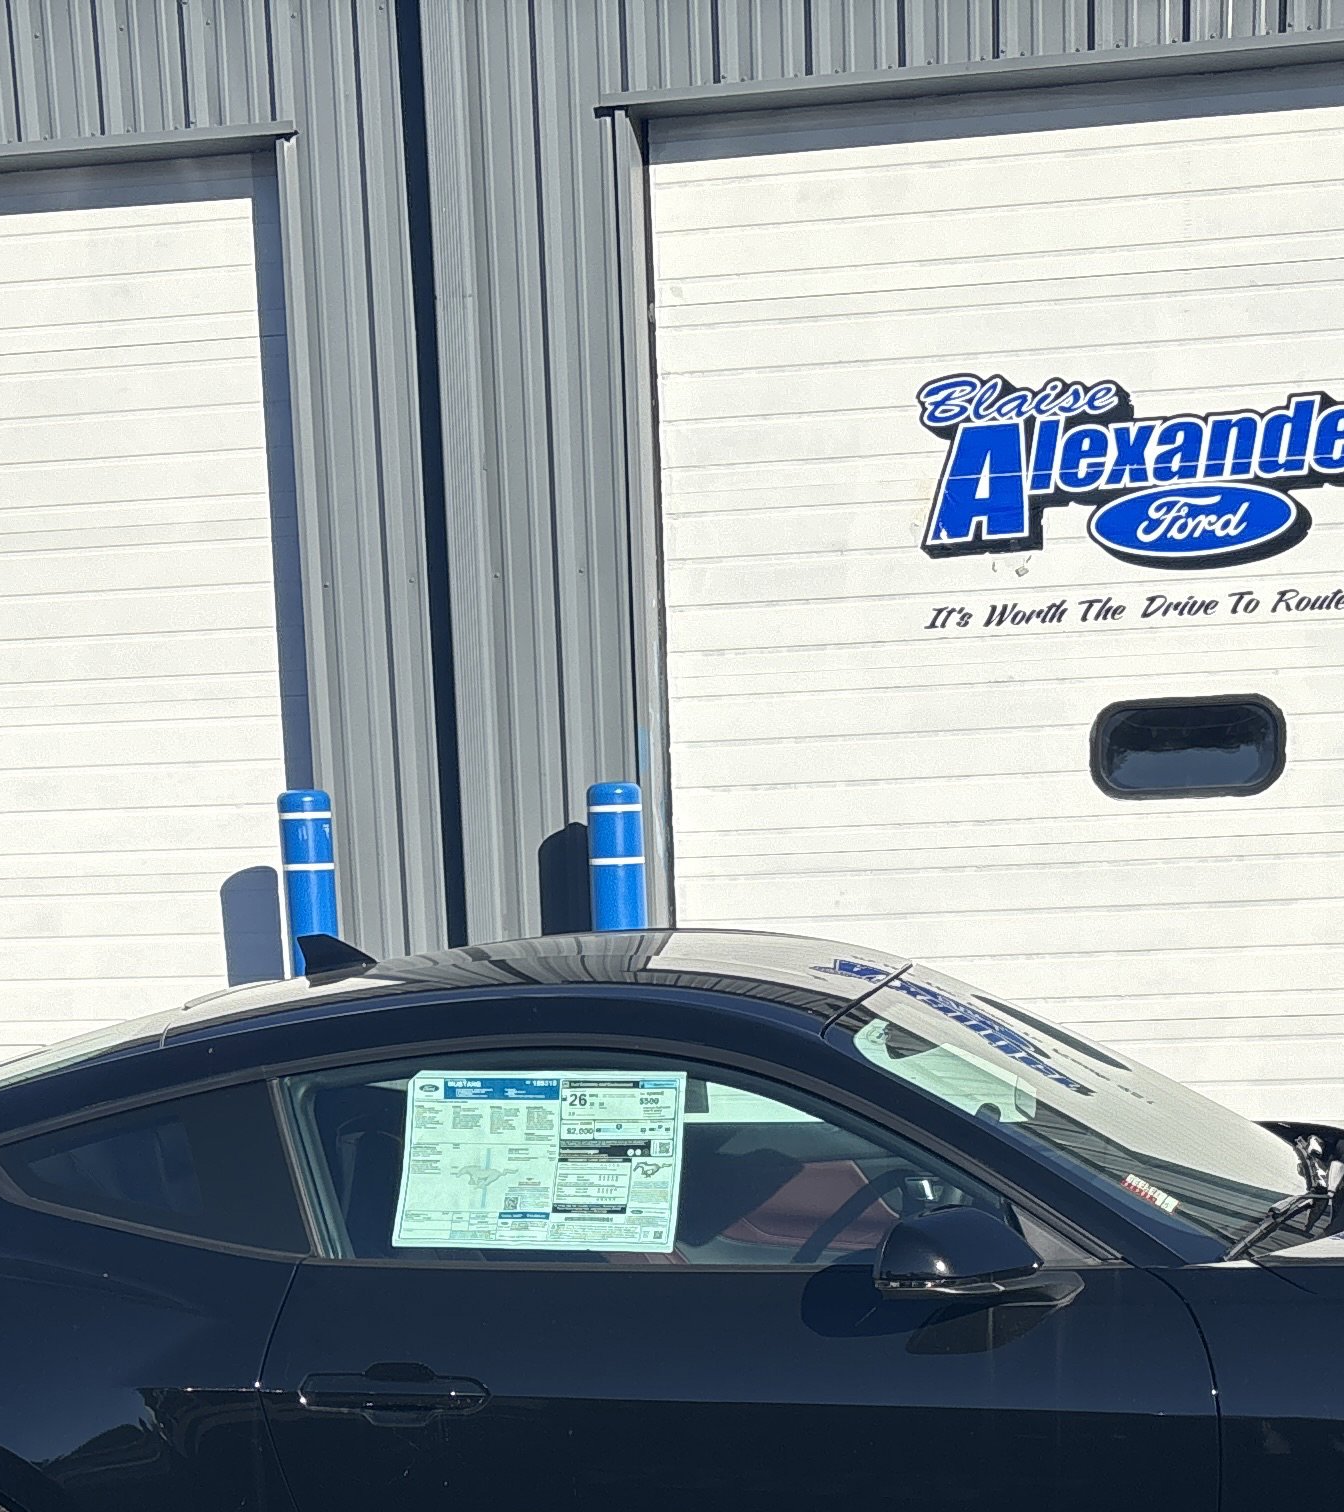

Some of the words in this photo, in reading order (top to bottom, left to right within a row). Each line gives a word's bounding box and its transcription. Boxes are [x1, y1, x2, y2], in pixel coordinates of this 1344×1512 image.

[920, 377, 1120, 426] Blaise
[1136, 493, 1248, 543] Ford
[924, 606, 974, 629] It's
[983, 599, 1068, 627] Worth
[1078, 597, 1127, 622] The
[1140, 594, 1219, 618] Drive
[1228, 590, 1261, 614] To
[569, 1093, 587, 1107] 26
